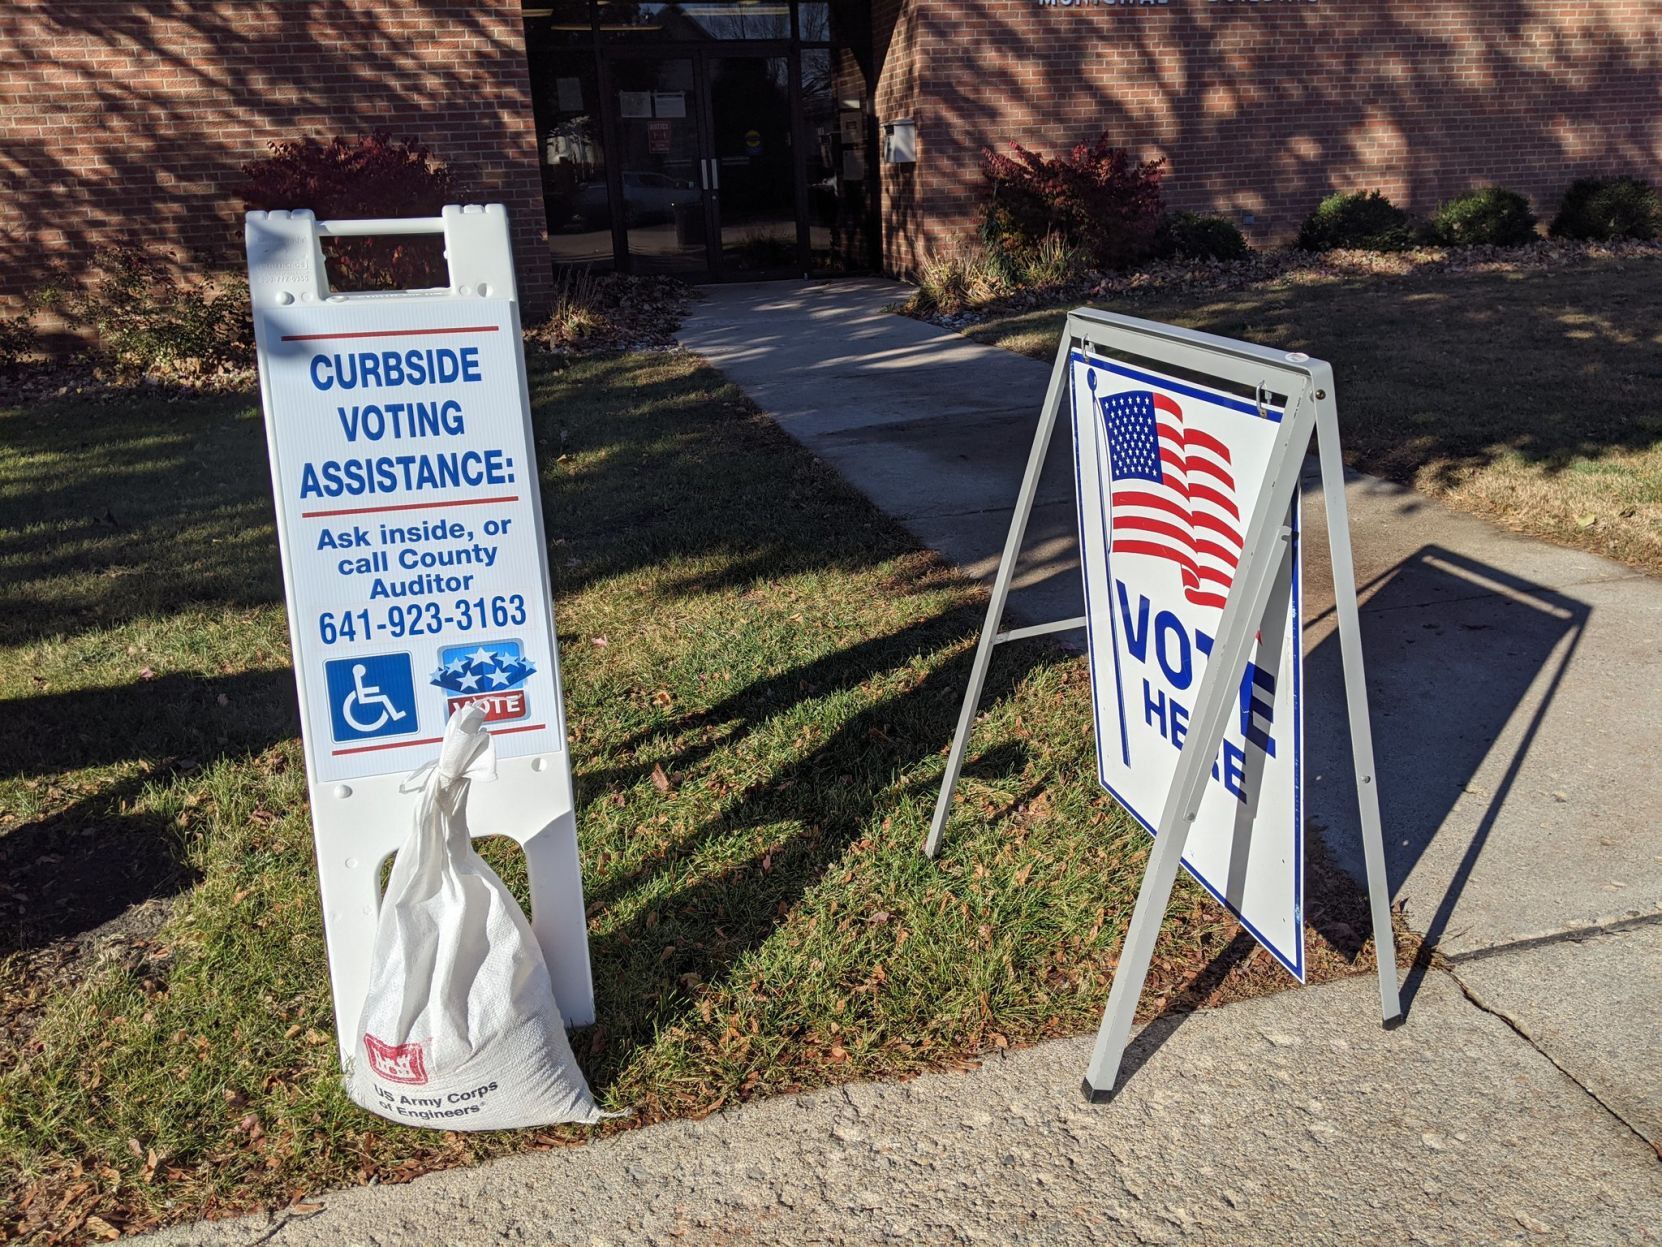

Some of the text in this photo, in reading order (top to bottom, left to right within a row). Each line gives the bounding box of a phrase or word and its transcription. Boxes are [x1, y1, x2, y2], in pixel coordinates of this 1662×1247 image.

[310, 346, 482, 391] CURBSIDE
[337, 400, 465, 442] VOTING
[300, 449, 516, 499] ASSISTANCE:
[317, 518, 512, 551] Ask inside, or
[338, 543, 498, 576] call County
[369, 574, 474, 600] Auditor
[319, 594, 527, 645] 641-923-3163
[1115, 578, 1277, 760] VOE
[1143, 677, 1248, 805] HEE
[373, 1081, 498, 1108] US Army Corps
[379, 1100, 393, 1111] of
